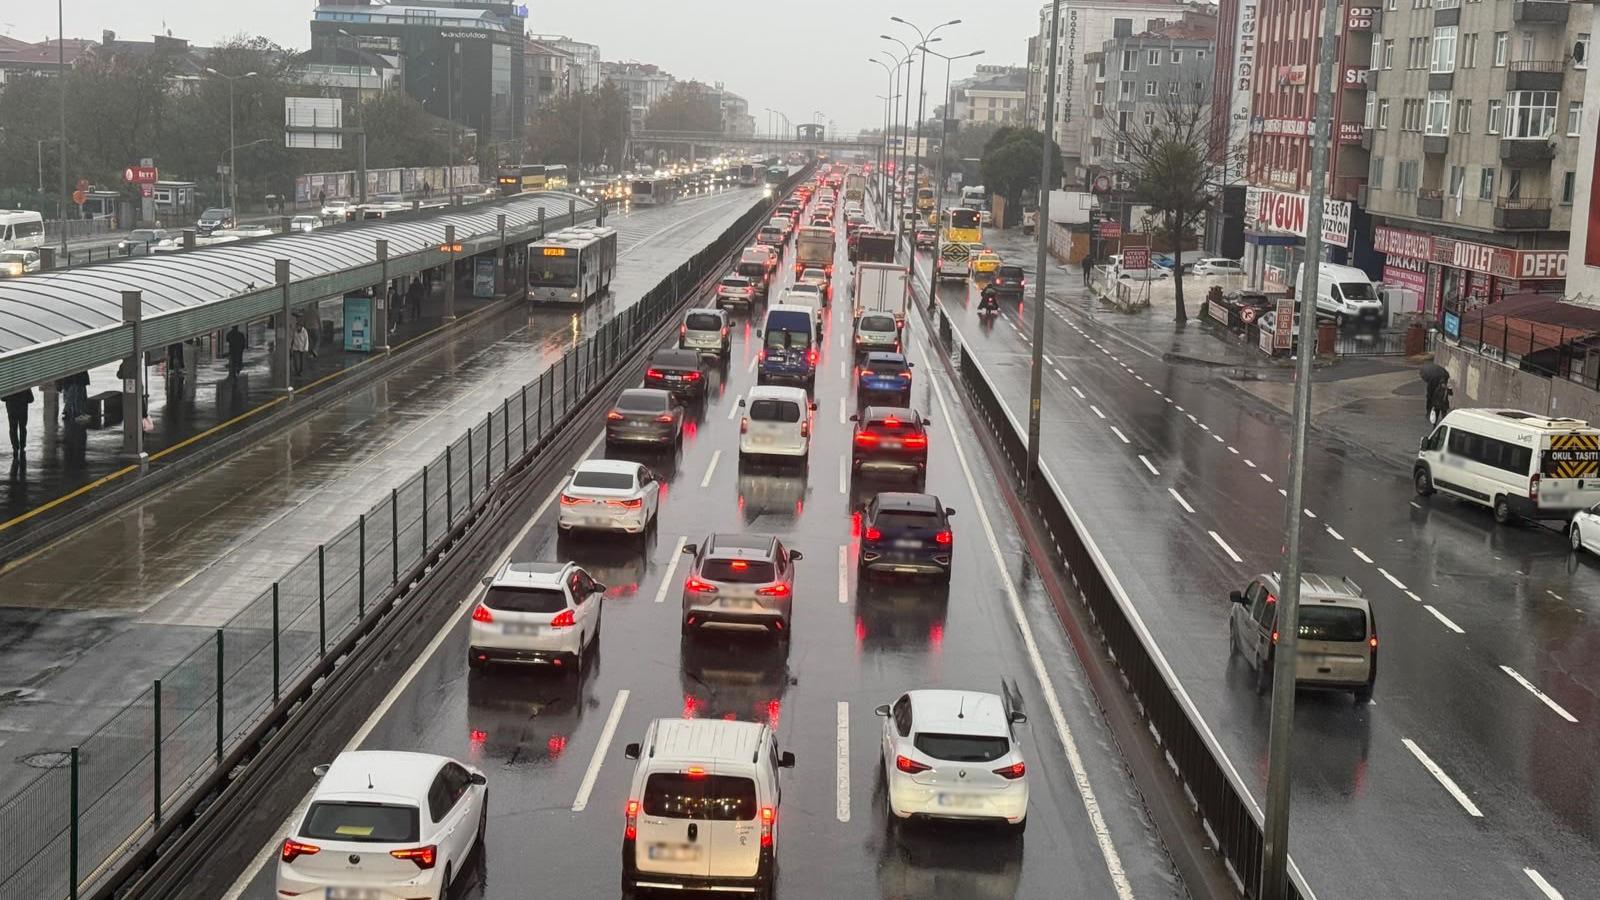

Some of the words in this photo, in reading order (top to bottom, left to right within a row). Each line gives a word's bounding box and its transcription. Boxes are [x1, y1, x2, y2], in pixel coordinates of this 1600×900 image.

[1259, 191, 1305, 232] UYGUN
[1454, 242, 1494, 272] OUTLET
[1552, 452, 1572, 460] OKUL
